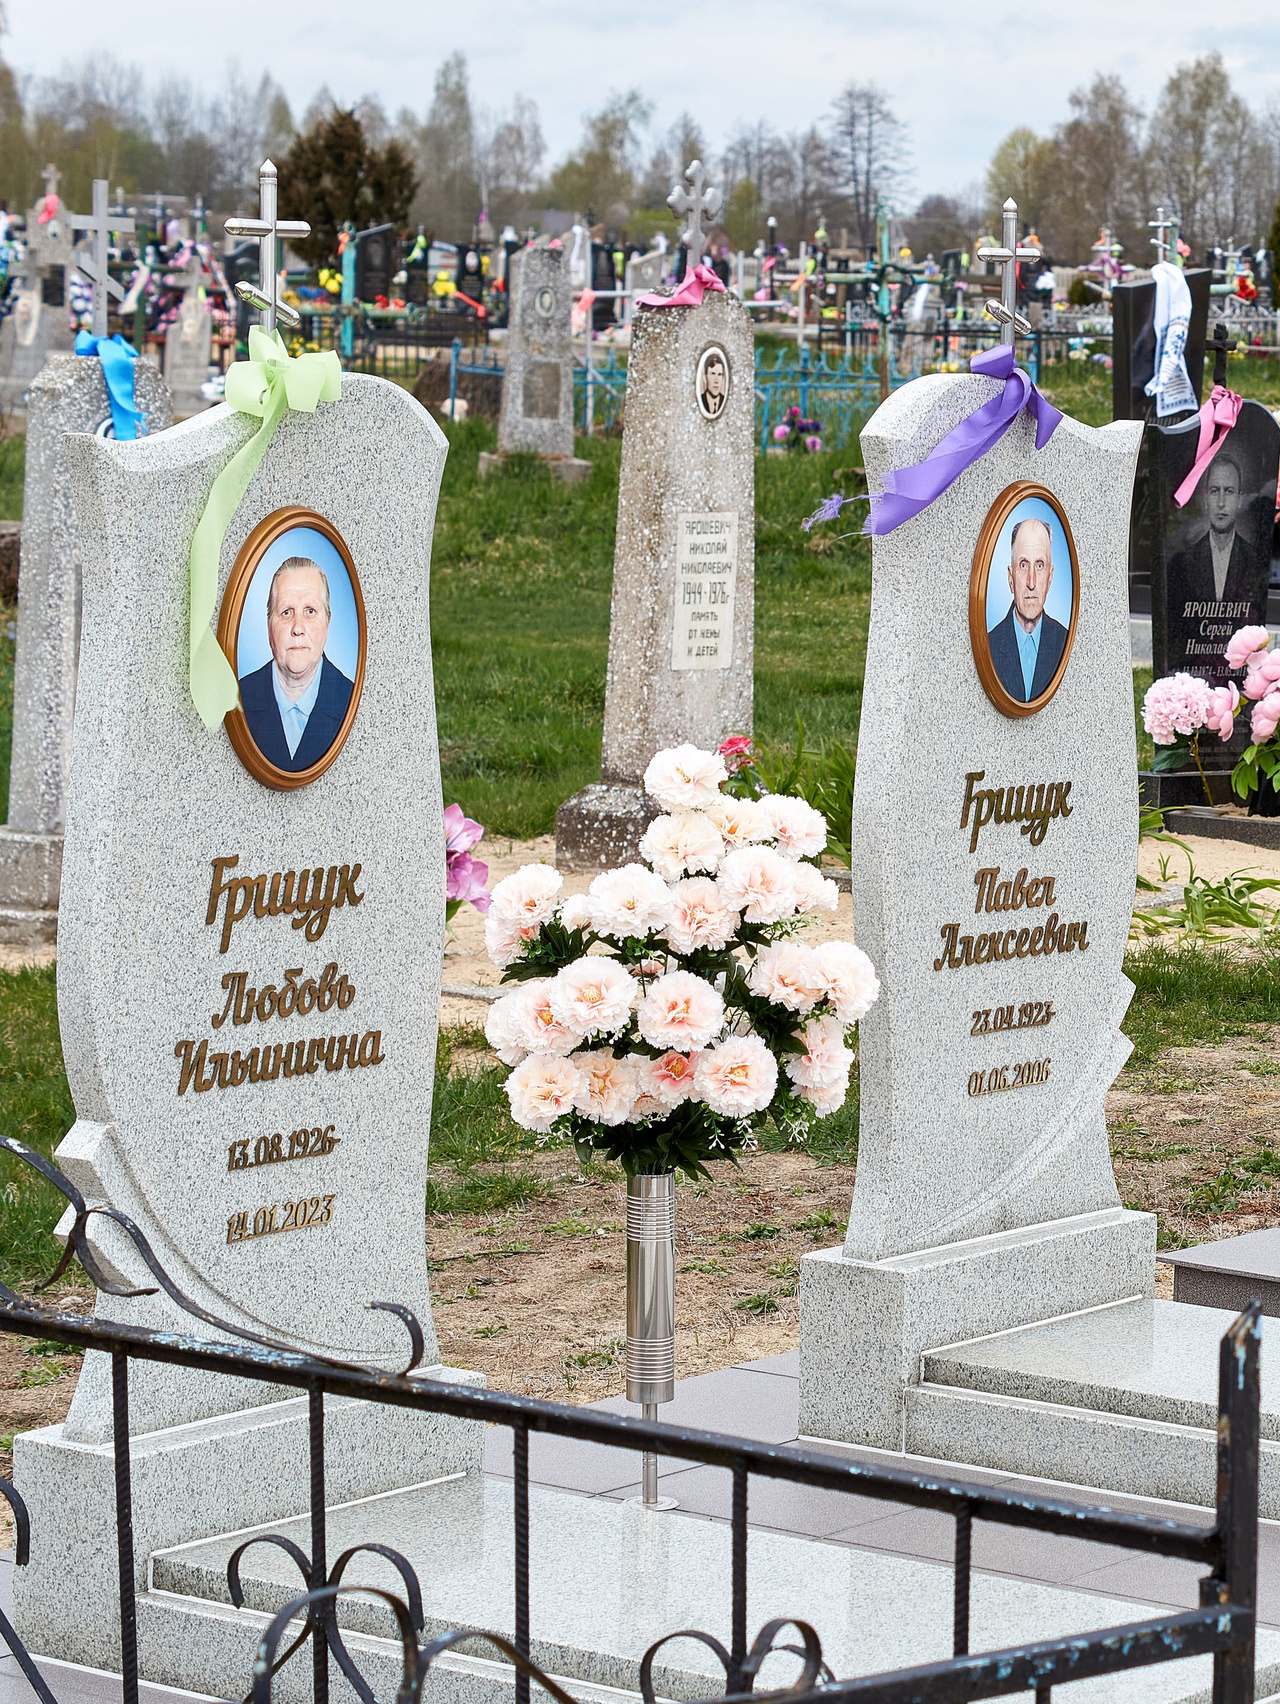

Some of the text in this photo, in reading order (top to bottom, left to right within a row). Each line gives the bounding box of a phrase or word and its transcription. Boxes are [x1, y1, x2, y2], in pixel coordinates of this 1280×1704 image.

[685, 520, 731, 535] ЯРОШЕВИЧ
[689, 538, 727, 555] НИКОЛАЙ
[681, 561, 732, 575] НИКОЛАЕВИЧ
[691, 611, 718, 622] ПАМЯТЬ
[1182, 601, 1251, 618] ЯРОШЕВИЧ
[688, 629, 720, 640] ОТ ЖЕНЫ
[1200, 620, 1233, 640] Сергей
[687, 643, 718, 657] И ДЕТЕЙ
[1185, 639, 1229, 655] Николае
[959, 769, 1073, 854] Грищук
[974, 866, 1057, 914] Павел
[205, 853, 365, 954] Грищук
[933, 912, 1090, 972] Алексеевич
[212, 961, 356, 1029] Любовь
[174, 1029, 386, 1097] Ильинична
[968, 1057, 1052, 1097] 01.06.2006
[226, 1194, 337, 1244] 14.01.2023
